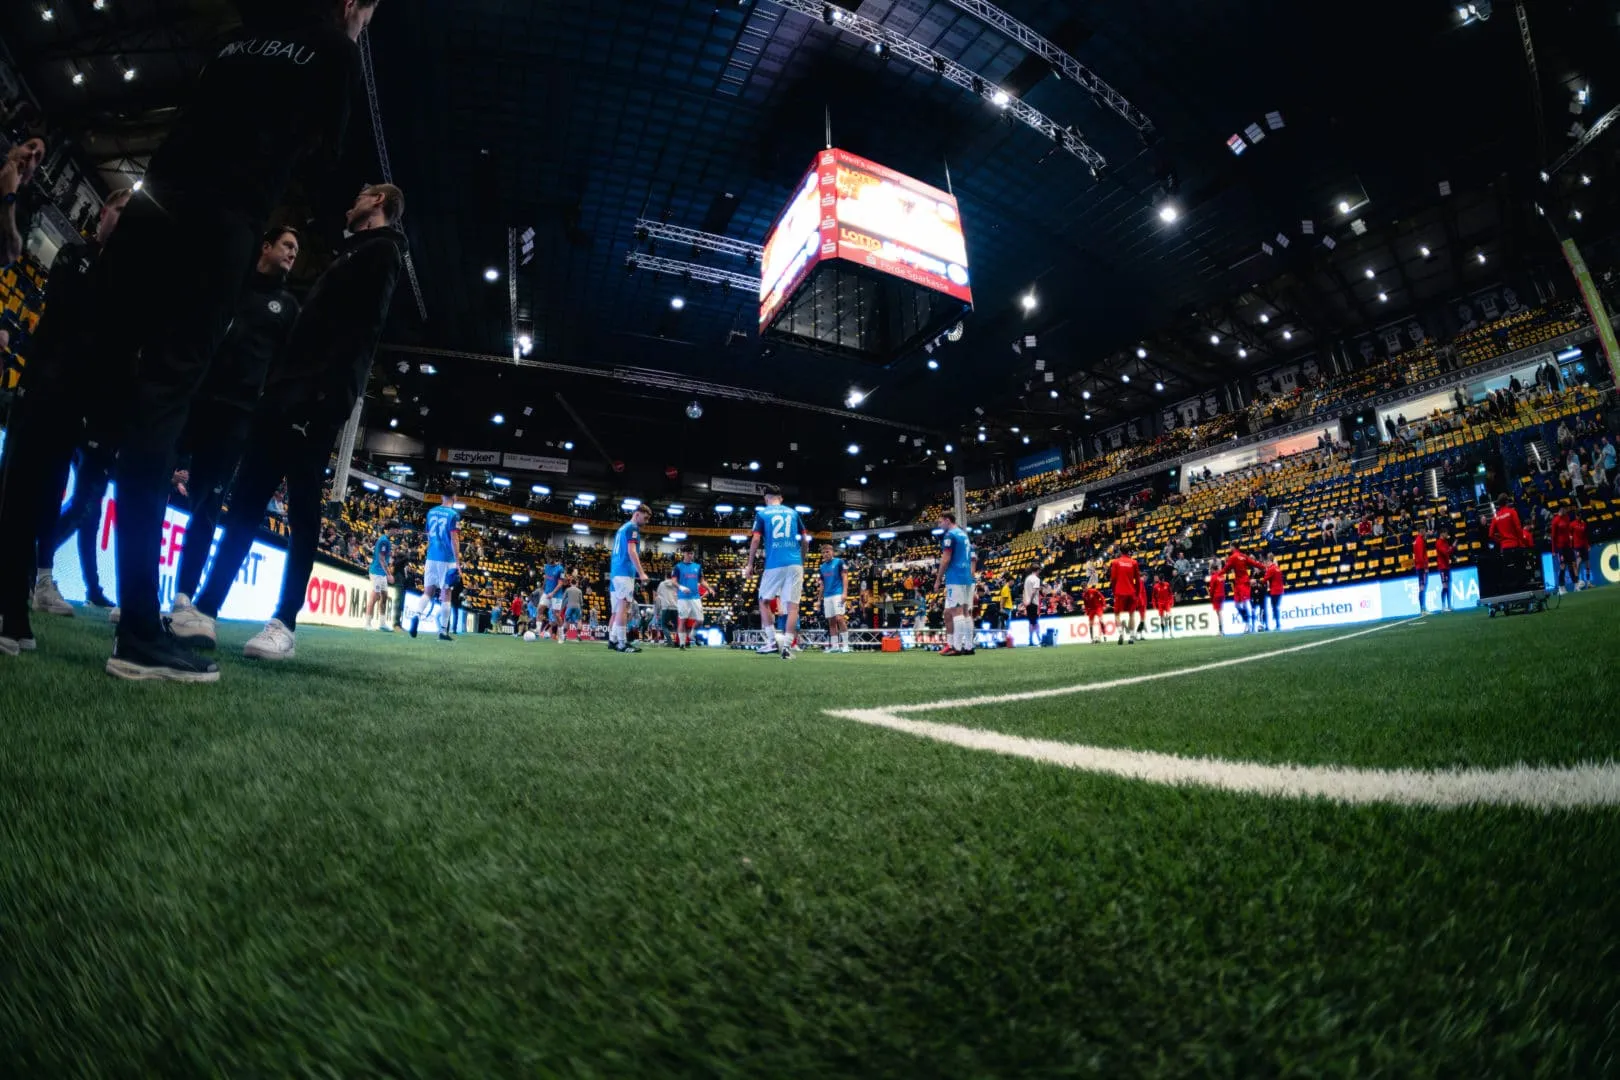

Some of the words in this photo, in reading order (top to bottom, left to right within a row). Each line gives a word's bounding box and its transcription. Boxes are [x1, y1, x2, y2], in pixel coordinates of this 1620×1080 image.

[841, 228, 881, 249] LOTTO
[453, 451, 495, 463] stryker
[771, 514, 792, 539] 21
[307, 576, 346, 616] OTTO
[1281, 602, 1353, 620] achrichten
[1070, 620, 1116, 638] LOO
